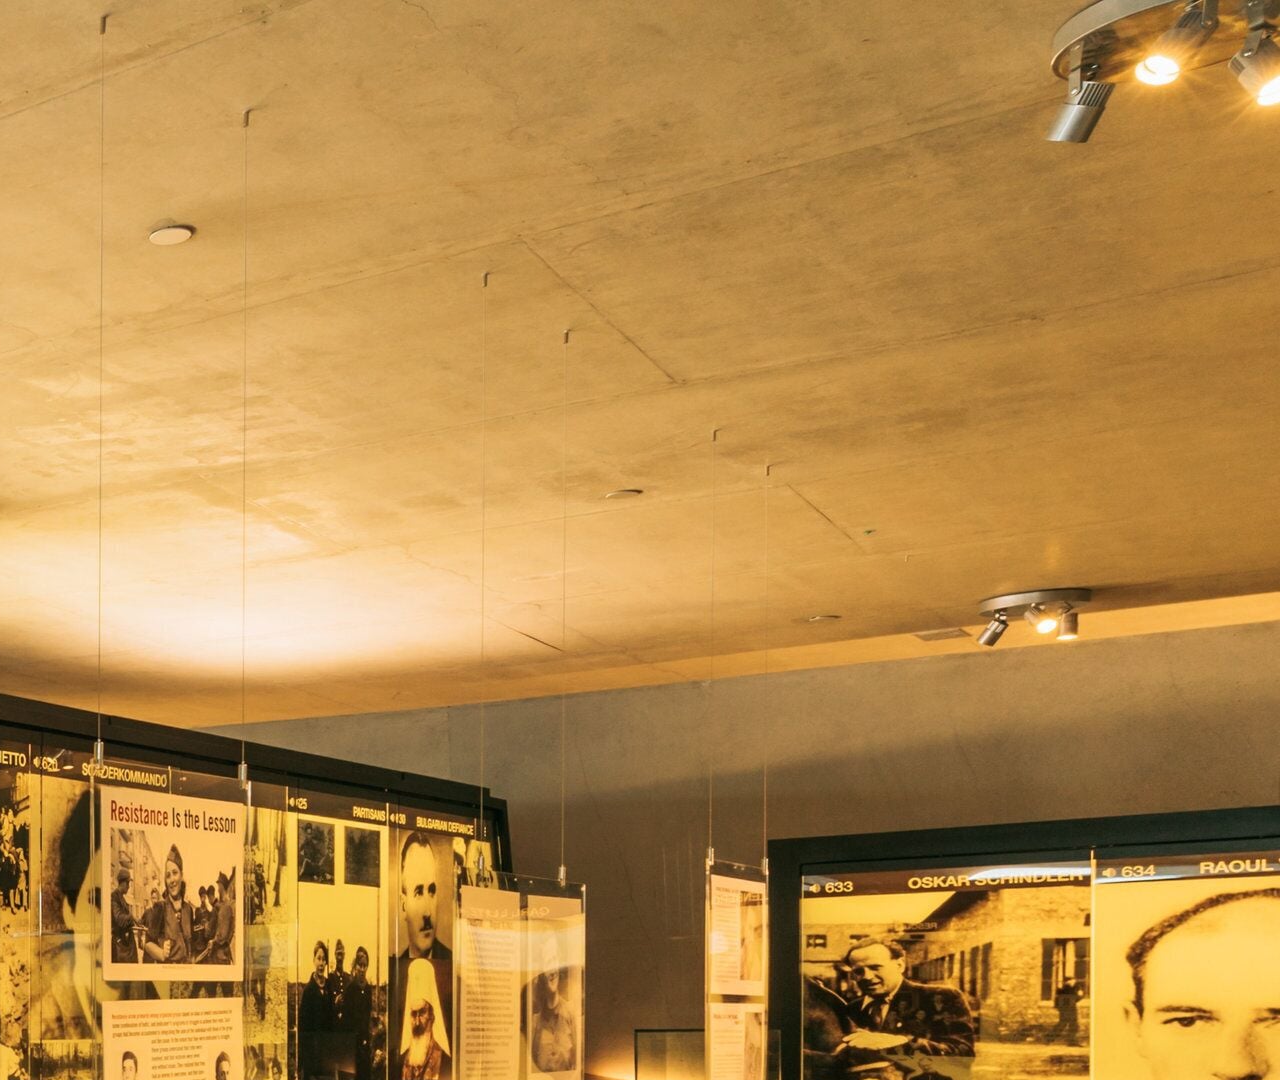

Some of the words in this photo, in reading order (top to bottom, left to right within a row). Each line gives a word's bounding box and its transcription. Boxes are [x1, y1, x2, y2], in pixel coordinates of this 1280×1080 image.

[111, 800, 169, 827] Resistance
[172, 807, 181, 828] Is
[184, 808, 200, 830] the
[203, 811, 236, 834] Lesson
[353, 806, 386, 822] PARTISANS
[416, 816, 447, 832] BULGARIAN
[447, 821, 475, 836] DEFIANCE
[1121, 865, 1156, 878] 634
[1200, 859, 1274, 874] RAOUL
[825, 882, 853, 893] 633
[908, 876, 970, 890] OSKAR
